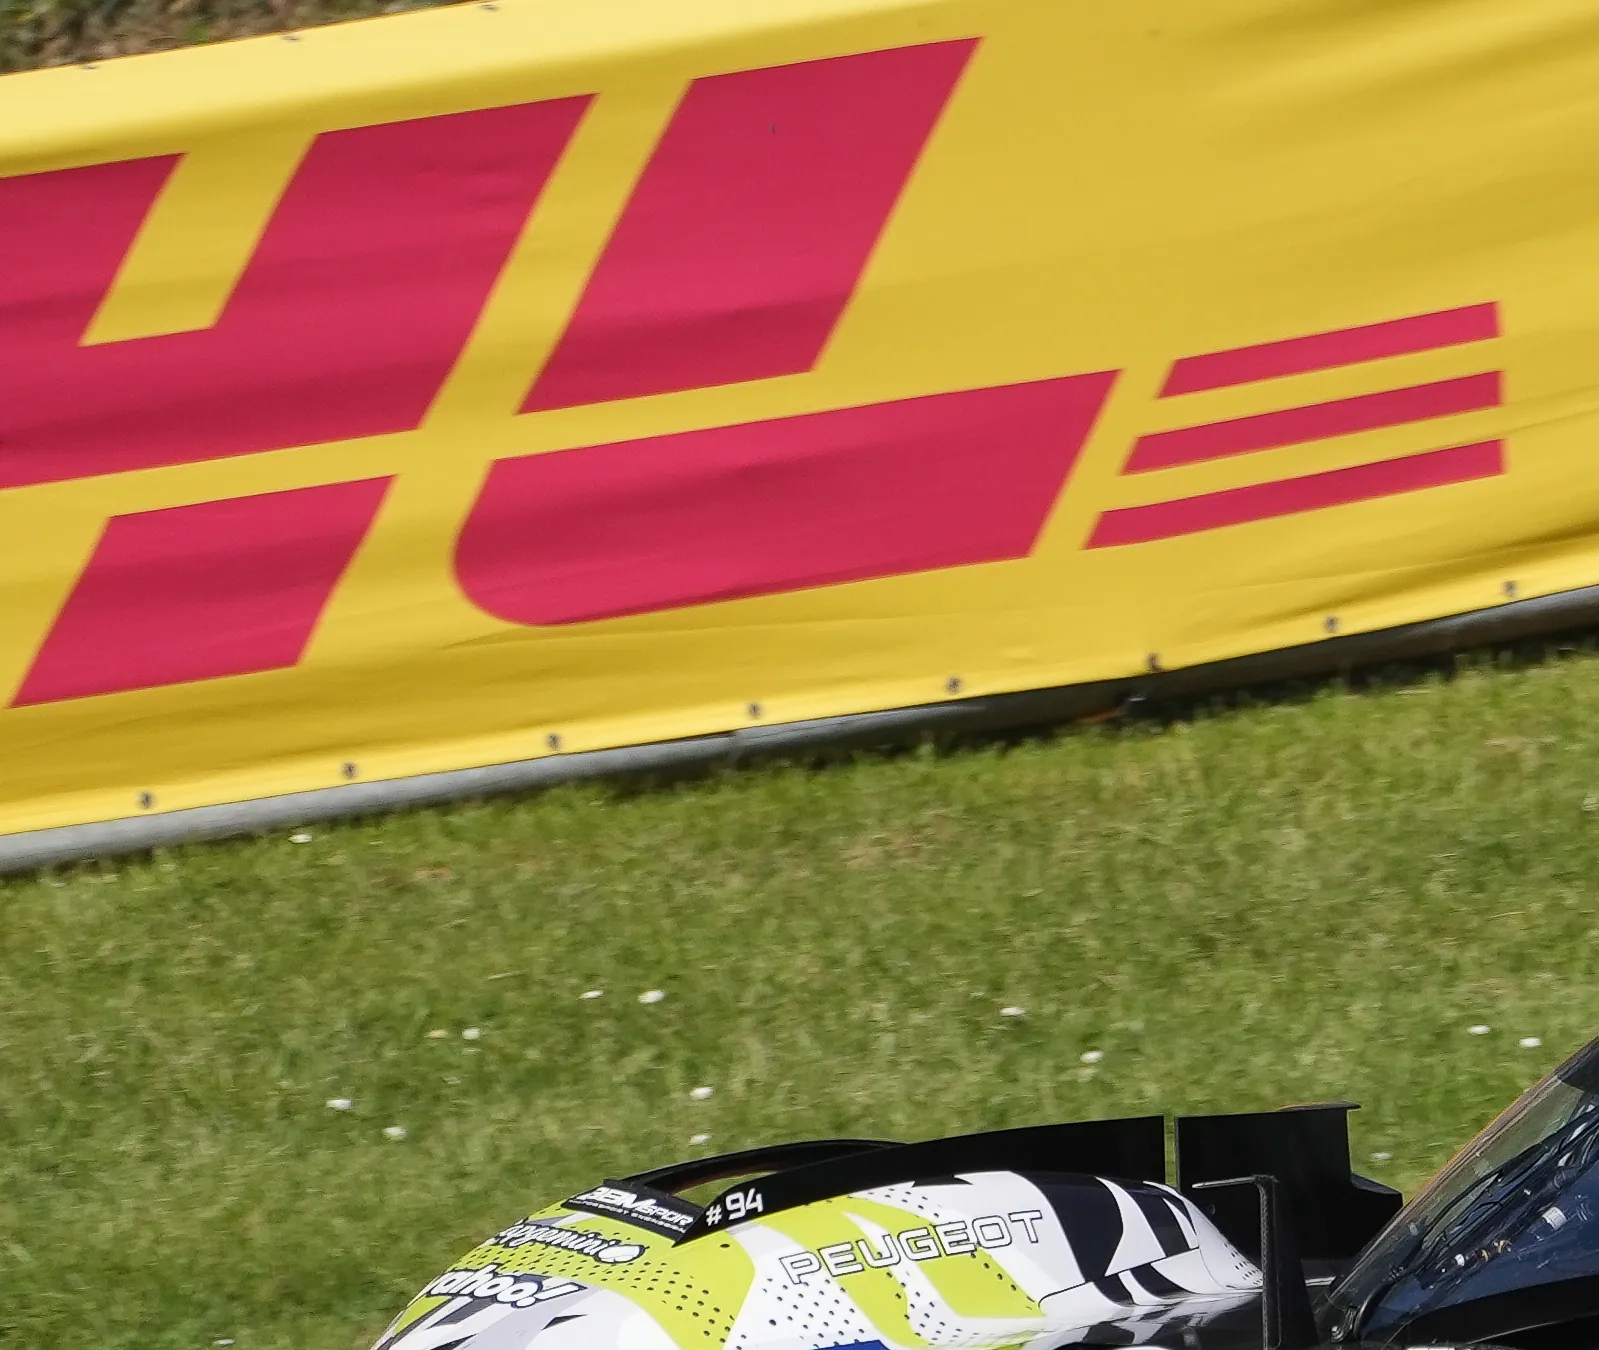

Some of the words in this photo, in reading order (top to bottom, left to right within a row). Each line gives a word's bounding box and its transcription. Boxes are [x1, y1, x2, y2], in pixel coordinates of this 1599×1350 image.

[0, 36, 1121, 710] HL
[778, 1209, 1043, 1285] PEUGEOT
[429, 1263, 587, 1308] ahoo!
